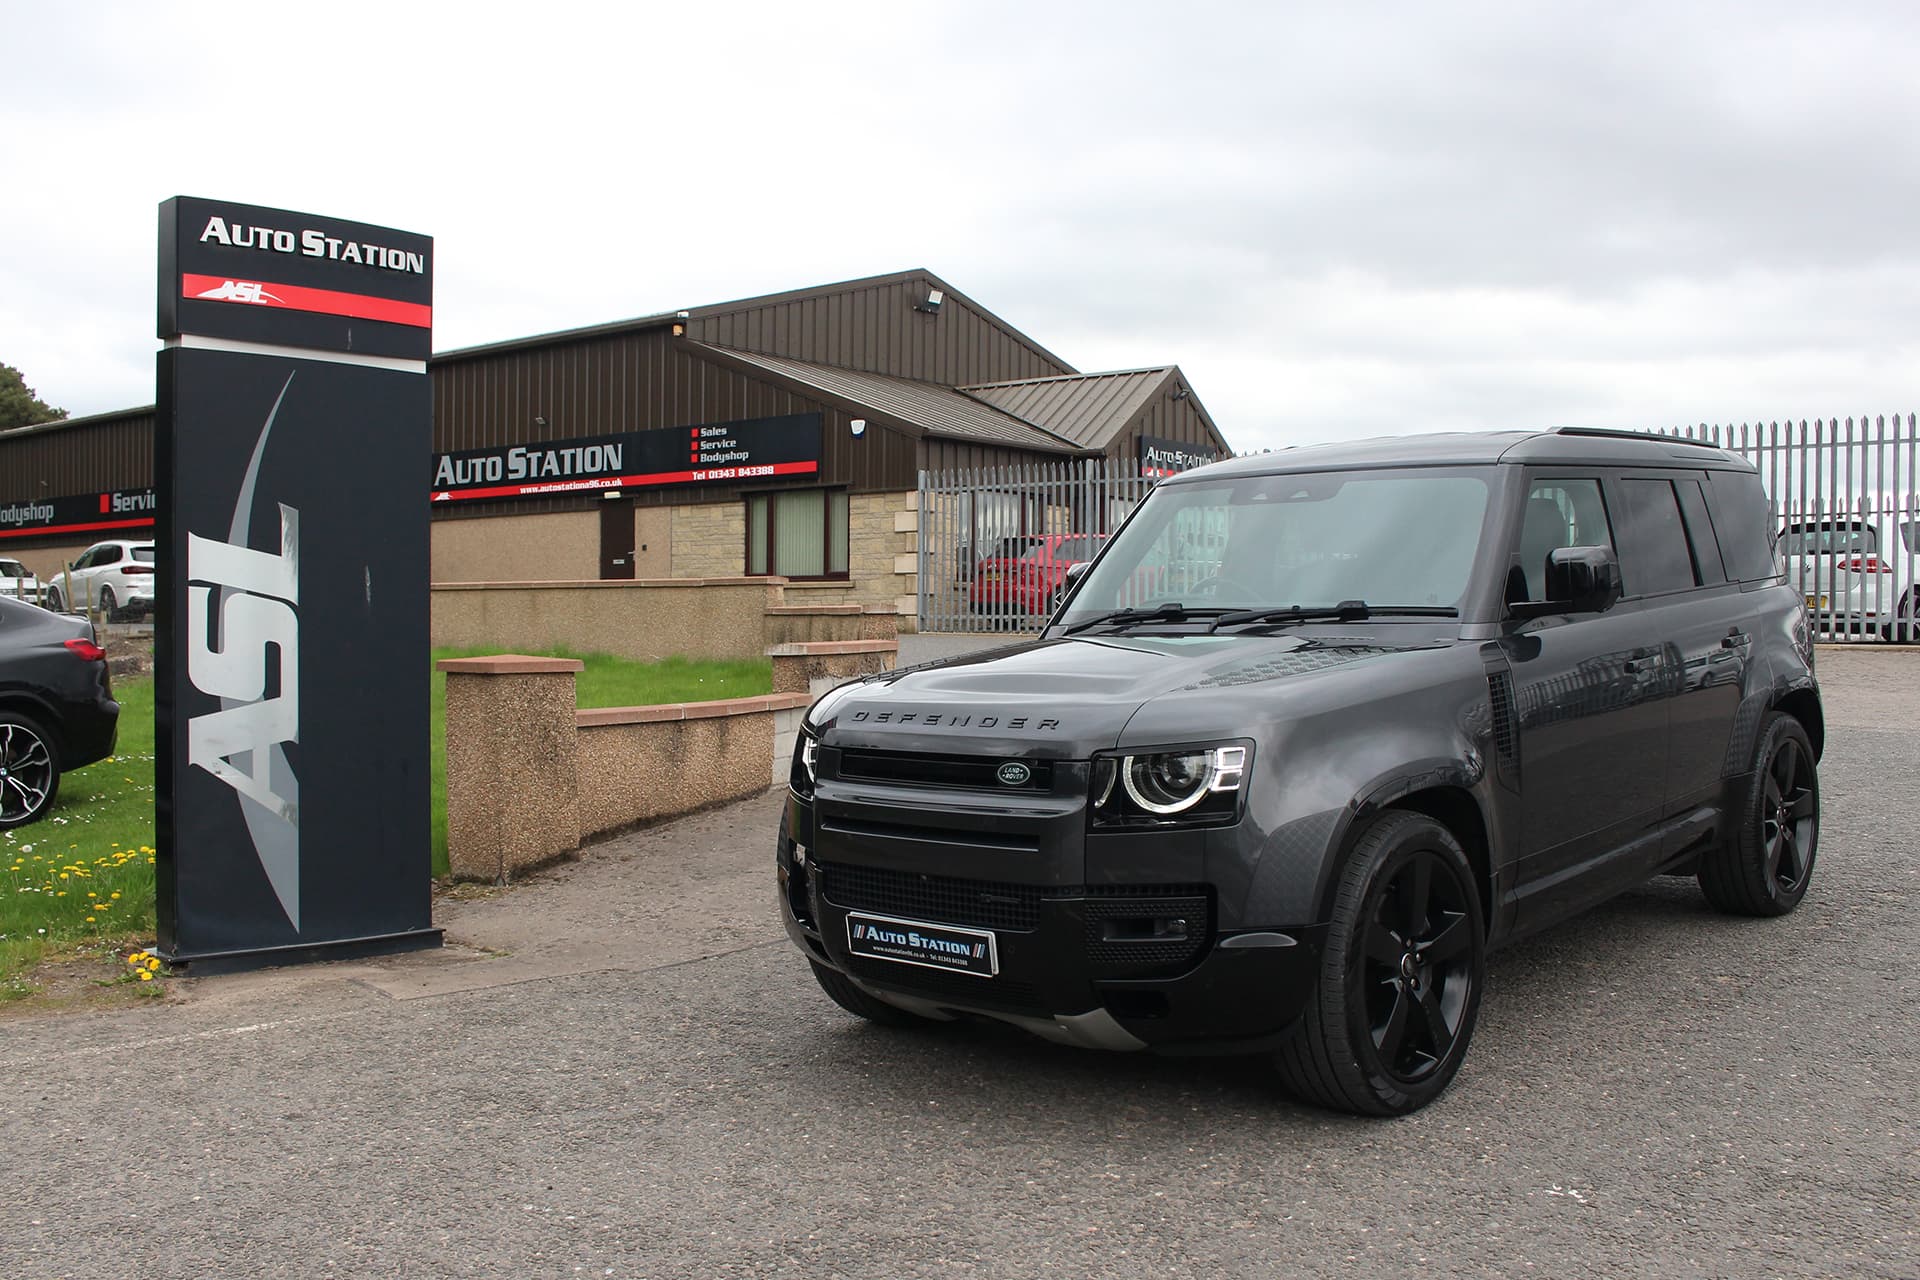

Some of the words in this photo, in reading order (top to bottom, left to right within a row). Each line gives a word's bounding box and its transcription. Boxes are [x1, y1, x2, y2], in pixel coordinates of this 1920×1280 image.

[200, 216, 295, 253] AUTO
[302, 230, 424, 275] STATION
[700, 427, 727, 437] Sales
[700, 440, 737, 450] Service
[434, 455, 502, 487] AUTO
[508, 443, 623, 480] STATION
[700, 451, 749, 463] Bodyshop
[692, 471, 706, 481] Tel
[708, 468, 735, 479] 01343
[0, 502, 54, 526] odyshop
[188, 502, 299, 830] ASL
[852, 711, 1060, 730] DEFENDER
[866, 926, 907, 945] AUTO
[908, 932, 970, 956] STATION
